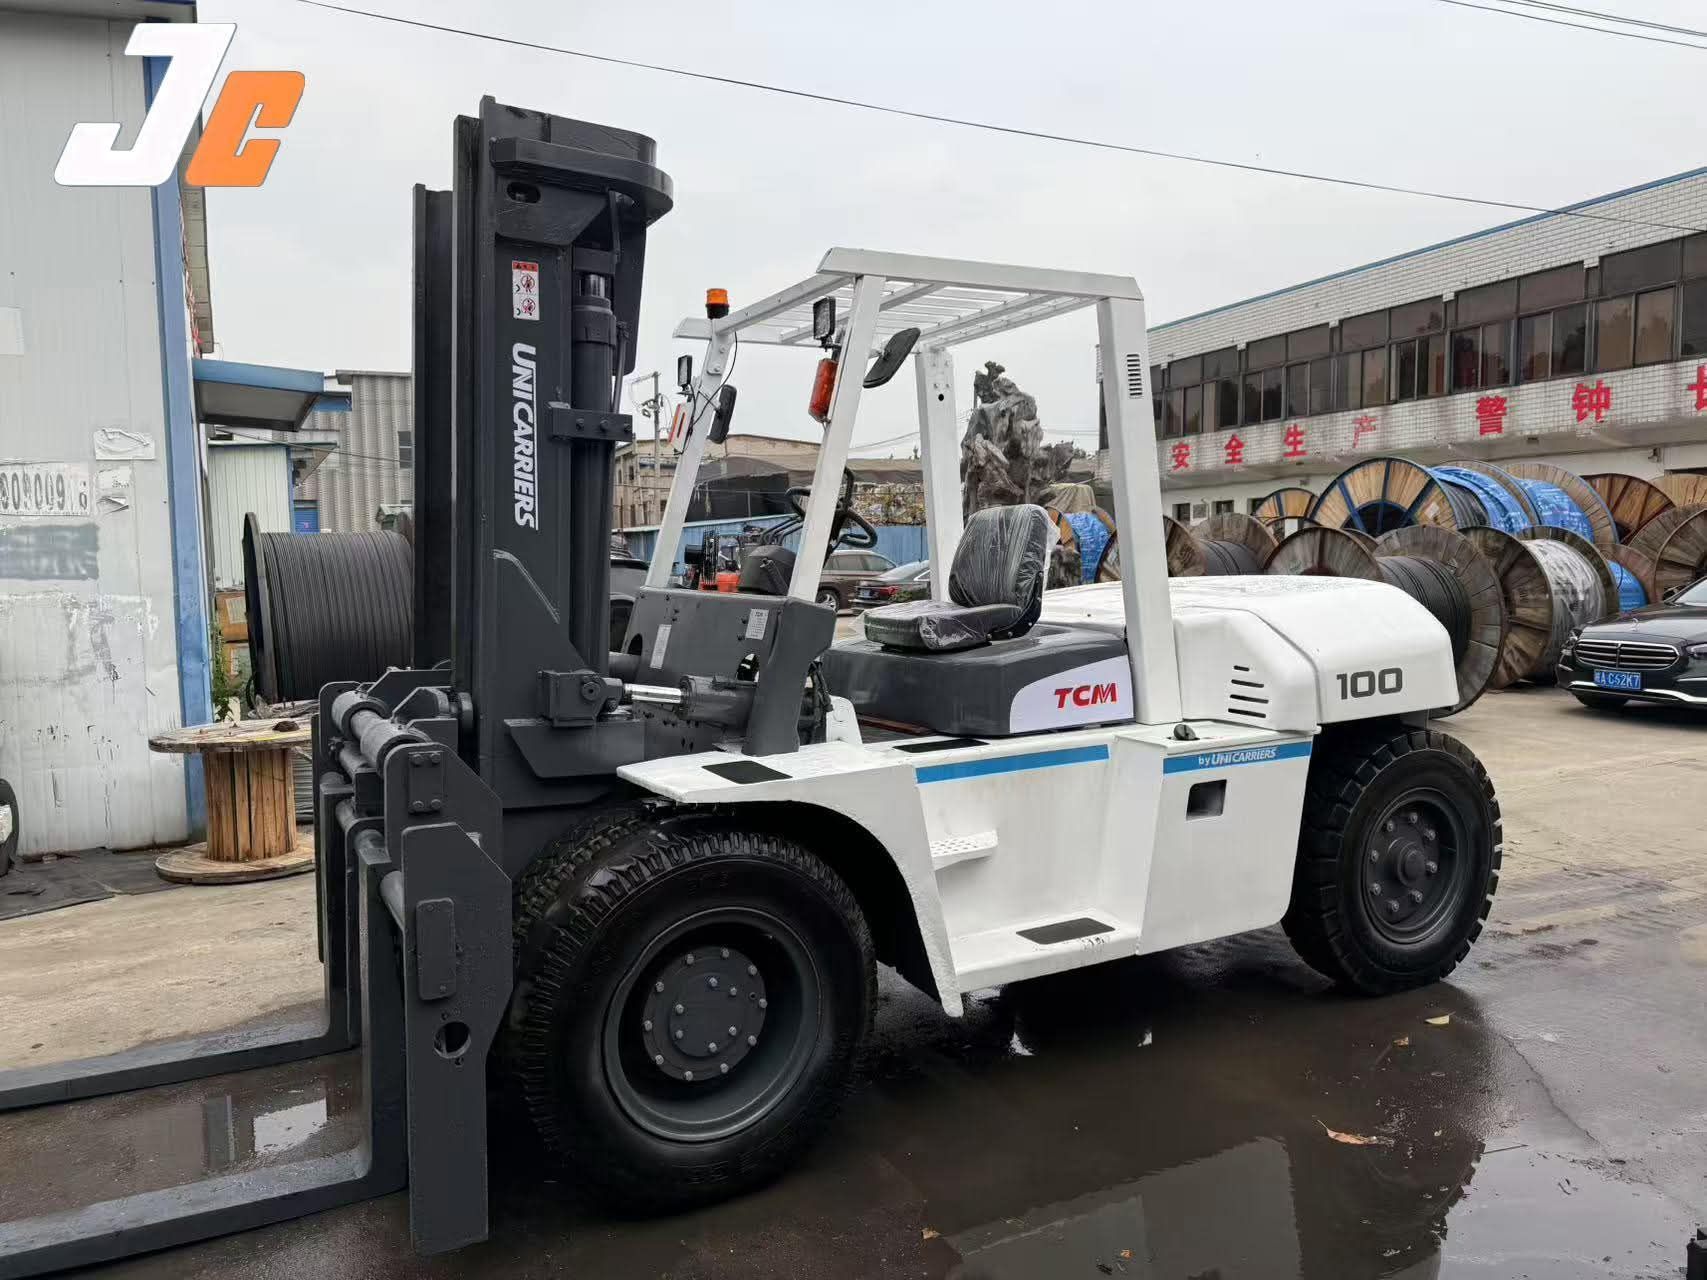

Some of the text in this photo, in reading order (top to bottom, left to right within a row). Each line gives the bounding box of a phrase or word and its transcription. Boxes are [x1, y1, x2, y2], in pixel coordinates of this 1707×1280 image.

[512, 342, 538, 531] UNICARRIERS
[1054, 682, 1118, 709] TCM
[1336, 667, 1403, 700] 100
